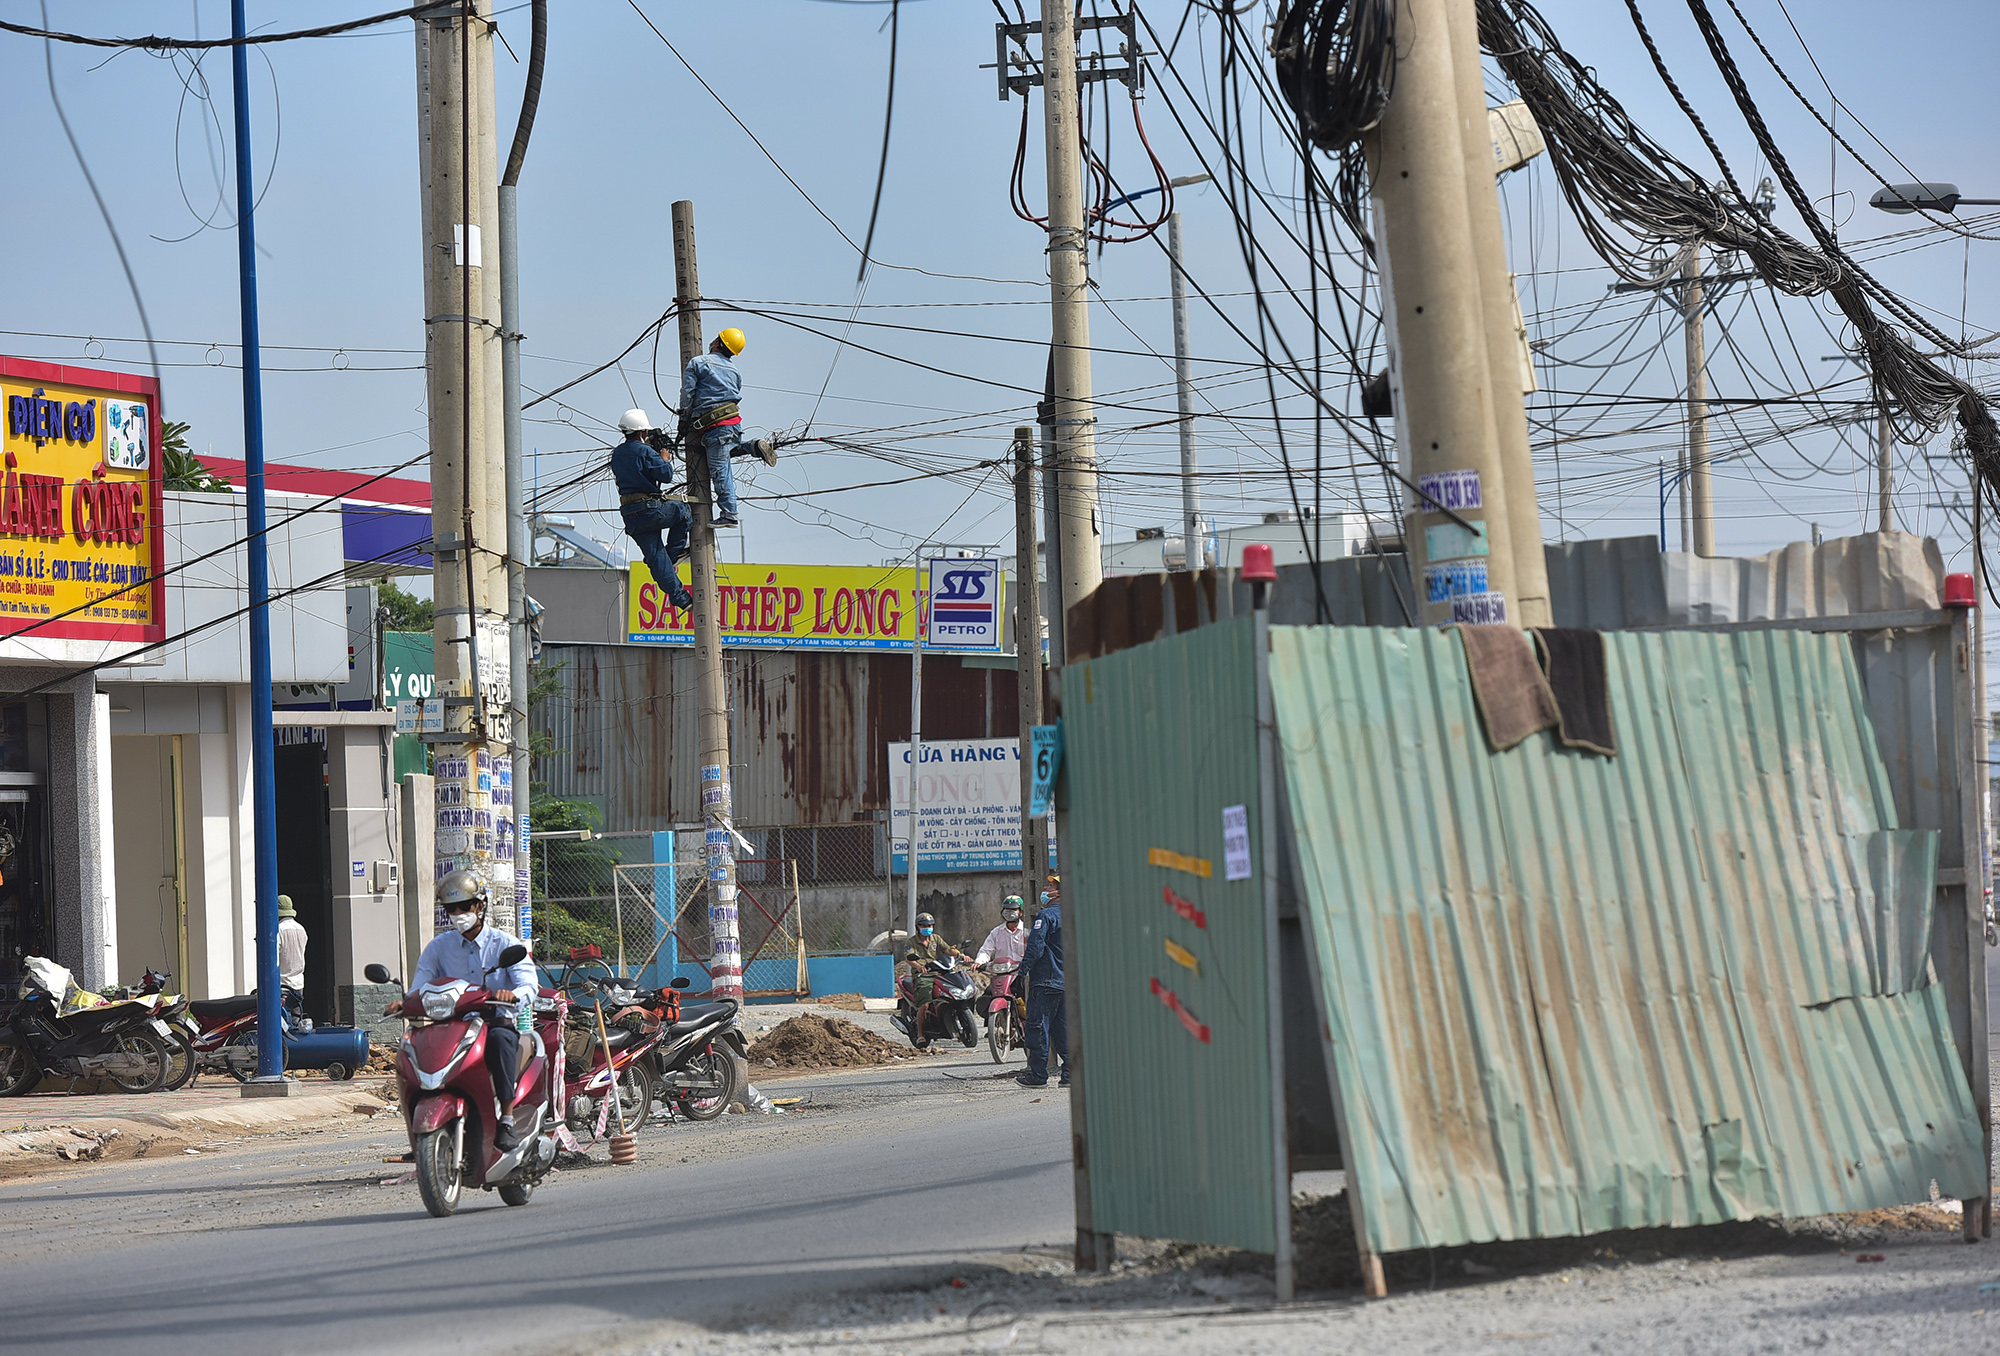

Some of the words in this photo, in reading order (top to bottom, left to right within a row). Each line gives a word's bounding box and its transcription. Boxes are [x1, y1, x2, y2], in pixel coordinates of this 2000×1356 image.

[9, 387, 63, 448] ĐIỆN
[65, 399, 97, 443] CƠ
[0, 452, 65, 538] ÀNH
[72, 462, 145, 544] CÔNG
[16, 549, 25, 577] SỈ
[26, 557, 34, 577] &
[35, 550, 45, 579] LẺ
[53, 559, 69, 580] CHO
[71, 557, 92, 582] THUÊ
[94, 558, 110, 583] CÁC
[111, 563, 128, 588] LOẠI
[130, 560, 147, 585] MÁY
[26, 579, 38, 595] BẢO
[39, 582, 55, 596] HÀNH
[935, 570, 993, 600] STS
[717, 571, 803, 632] THÉP
[812, 587, 902, 637] LONG
[939, 626, 986, 635] PETRO
[903, 744, 943, 764] CỬA
[951, 745, 1006, 762] HÀNG
[920, 808, 941, 816] DOANH
[943, 805, 956, 815] CÂY
[983, 804, 1004, 814] PHÔNG
[950, 817, 963, 826] CÂY
[965, 815, 986, 825] CHỐNG
[992, 815, 1005, 824] TÔN
[996, 828, 1016, 836] THEO
[894, 843, 909, 851] CHO
[931, 839, 945, 850] CỐT
[947, 841, 961, 849] PHA
[986, 838, 1003, 848] GIÁO
